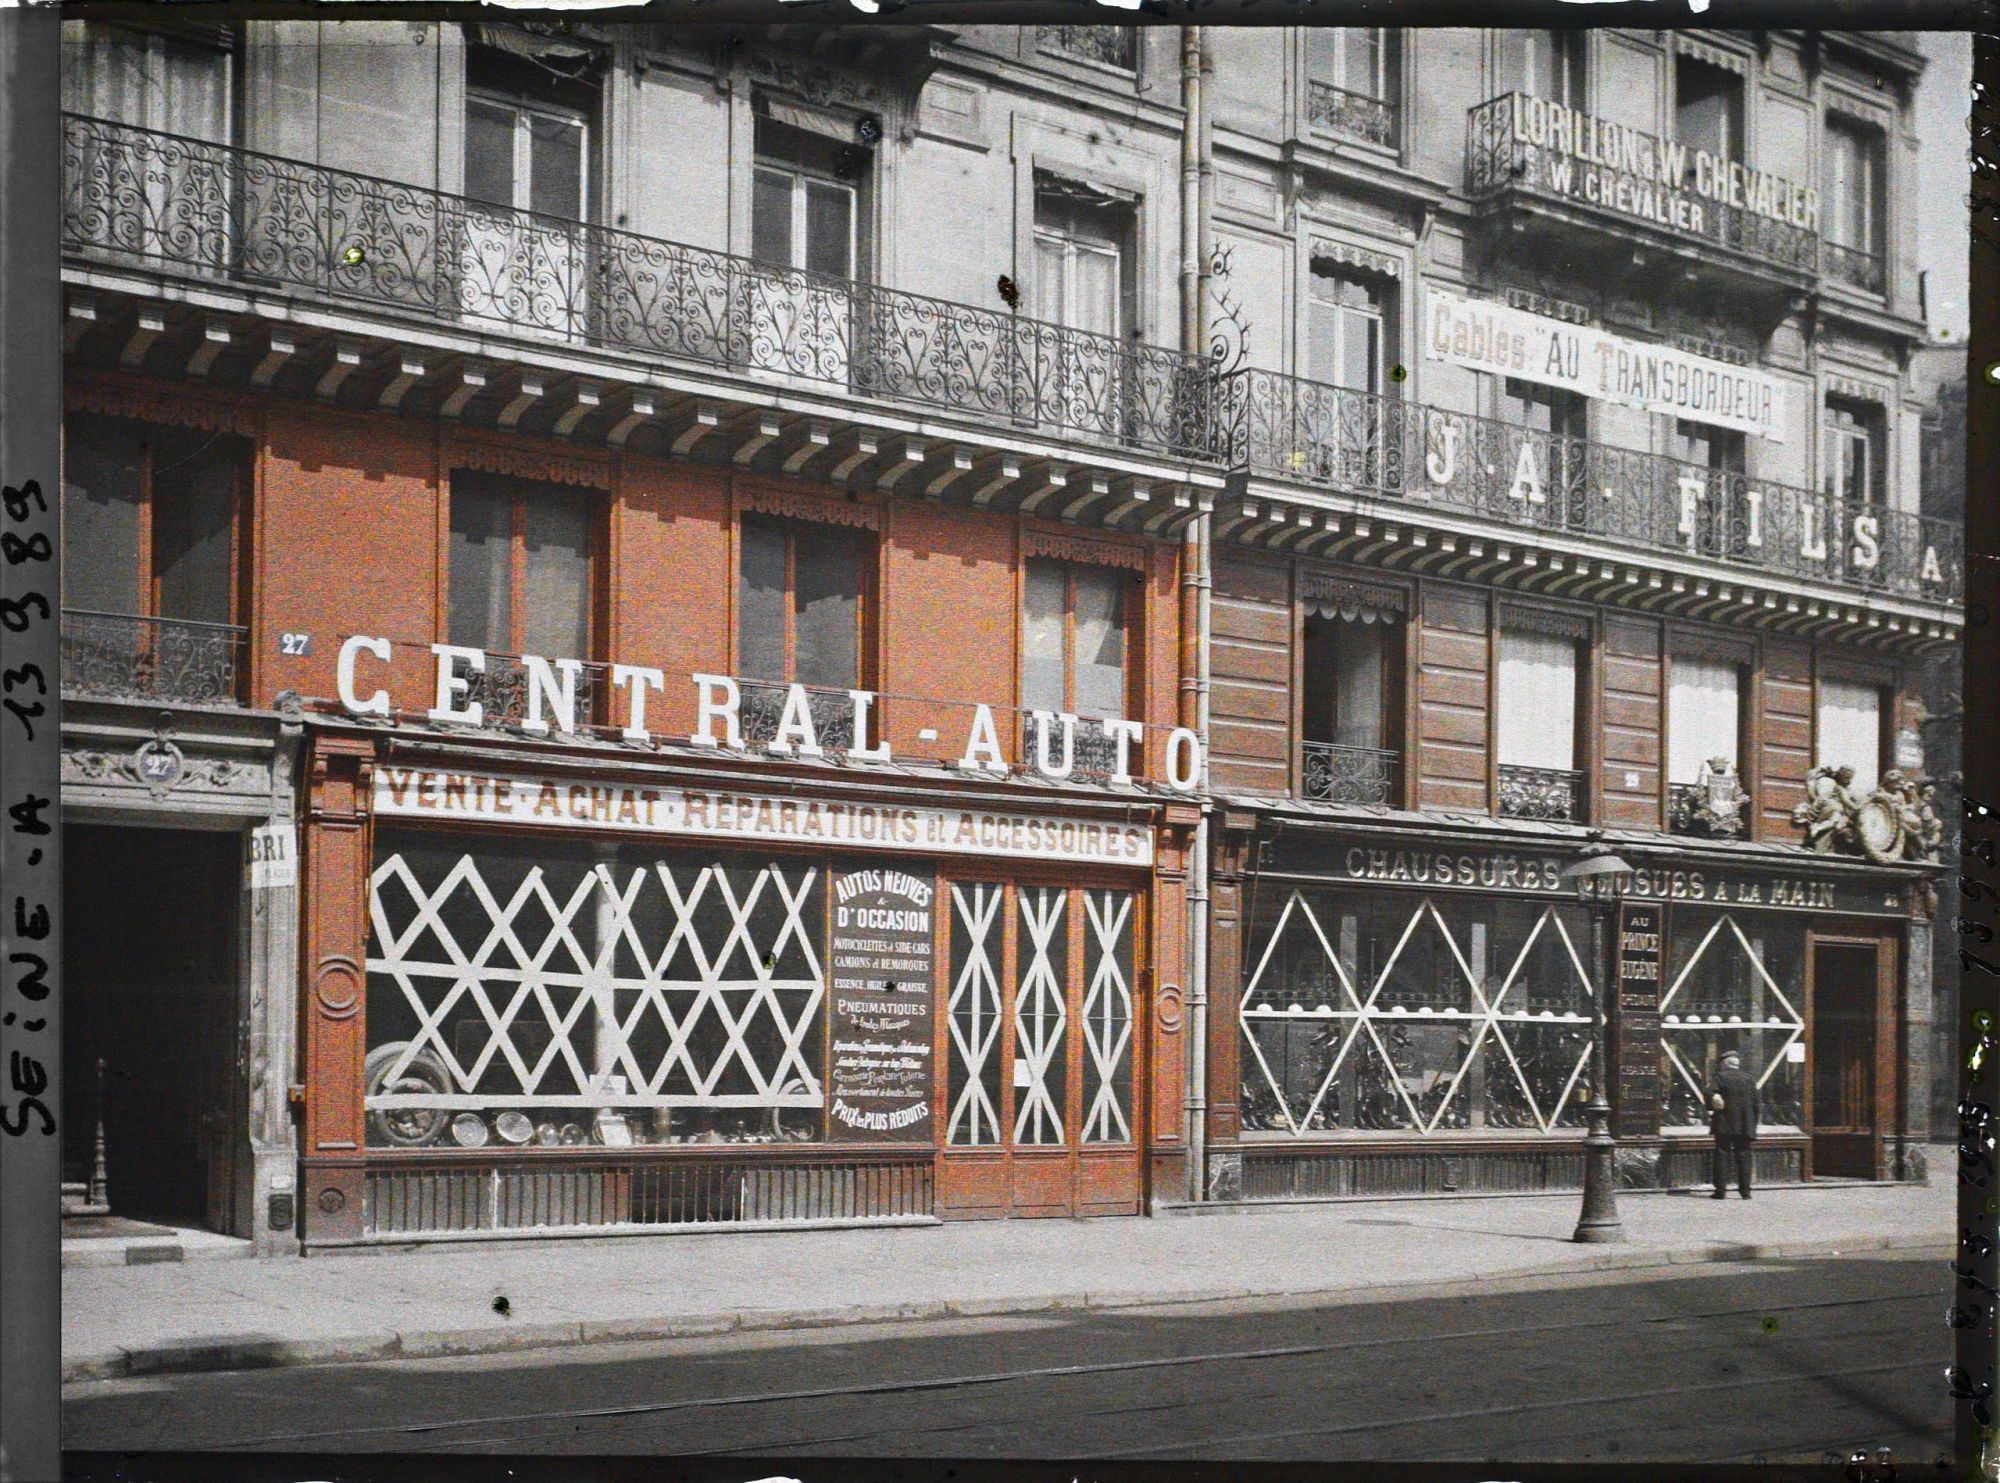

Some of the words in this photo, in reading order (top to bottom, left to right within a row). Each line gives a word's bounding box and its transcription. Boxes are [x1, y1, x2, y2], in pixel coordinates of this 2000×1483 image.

[1585, 173, 1703, 232] CHEVALIER
[1696, 150, 1820, 234] CHEVALIER
[1677, 476, 1880, 569] FILS
[0, 479, 51, 633] 989
[282, 633, 309, 655] 27
[147, 755, 171, 777] 27
[381, 767, 513, 814] VENTE
[533, 780, 660, 825] ACHAT
[927, 814, 946, 843] et
[953, 812, 1140, 858] ACCESSOIRES
[835, 869, 882, 904] AUTOS
[884, 869, 933, 907] NEUVES
[1346, 847, 1560, 890] CHAUSSURES
[1737, 883, 1762, 903] LA
[1769, 879, 1836, 908] MAIN
[1630, 916, 1649, 927] AU
[833, 937, 887, 953] MOTOCYCLETTES
[1621, 931, 1659, 953] PRINCE
[834, 955, 871, 969] CAMIONS
[881, 958, 929, 972] REMORQUES
[837, 999, 926, 1016] PNEUMATIQUES
[831, 1097, 860, 1128] PRIX
[864, 1111, 888, 1131] PLUS
